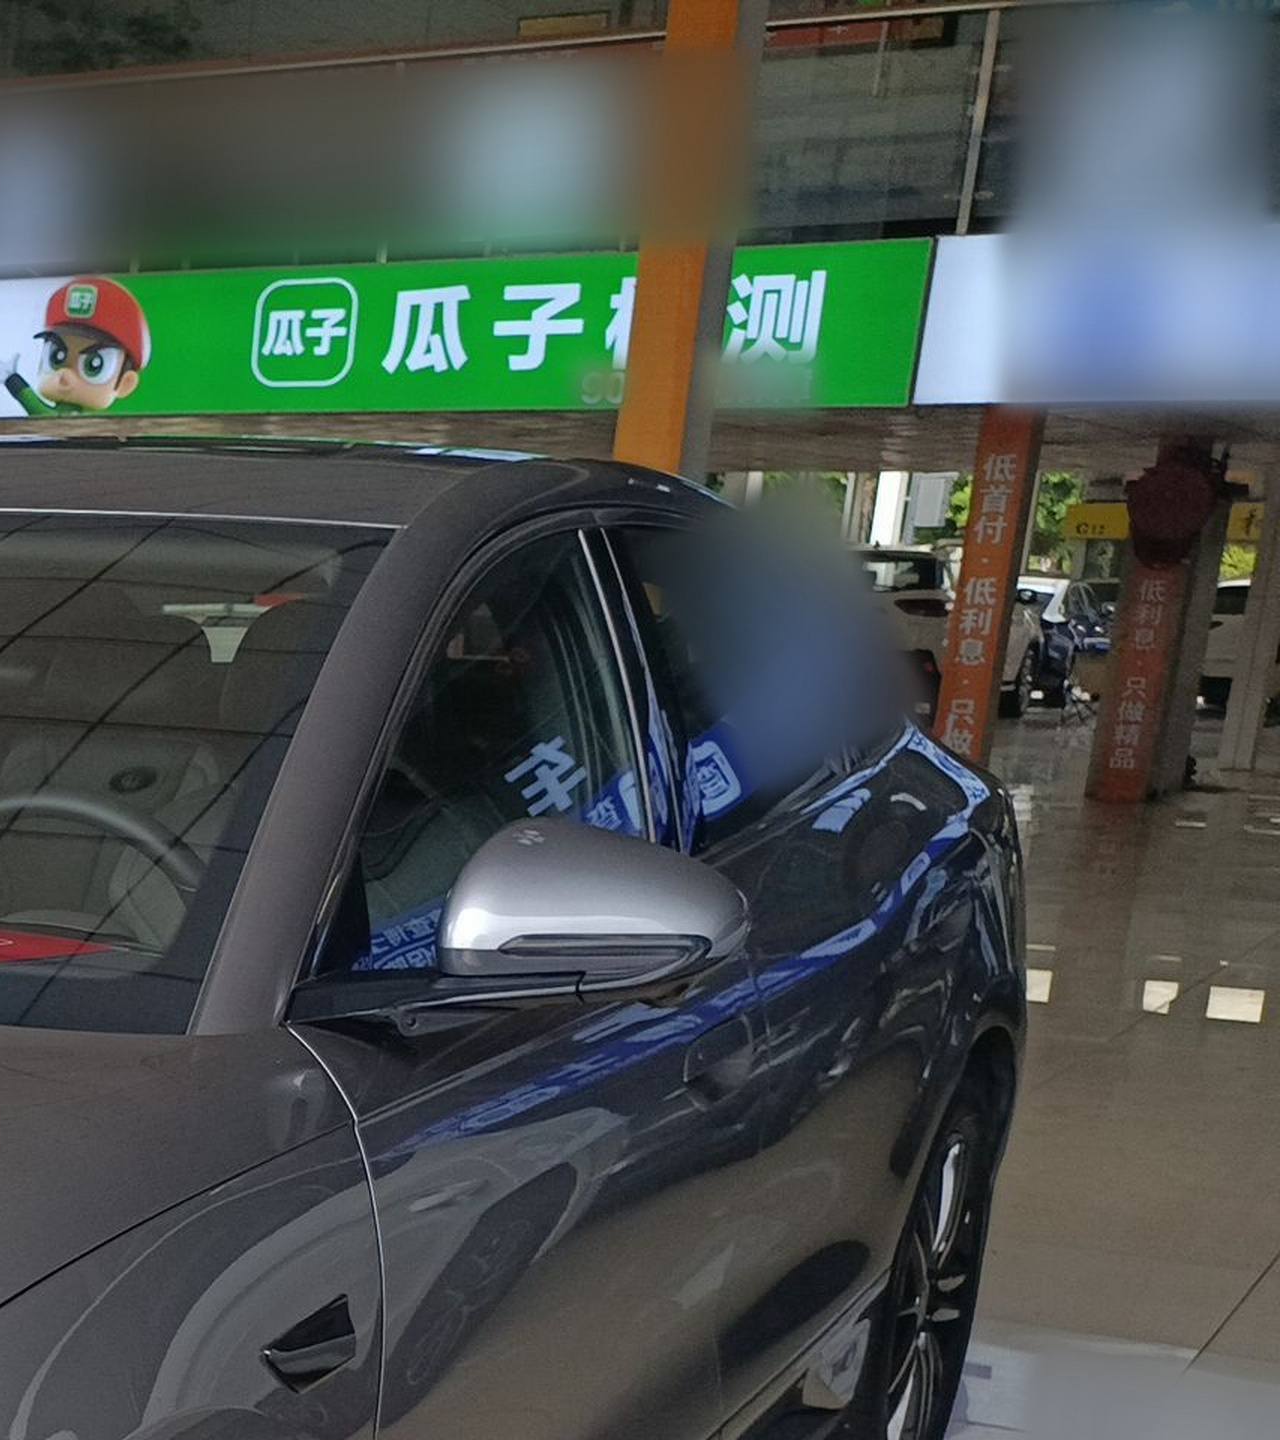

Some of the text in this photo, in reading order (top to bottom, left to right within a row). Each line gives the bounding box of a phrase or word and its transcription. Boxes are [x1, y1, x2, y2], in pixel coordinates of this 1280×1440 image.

[261, 308, 348, 356] 瓜子
[381, 268, 827, 376] 瓜子测
